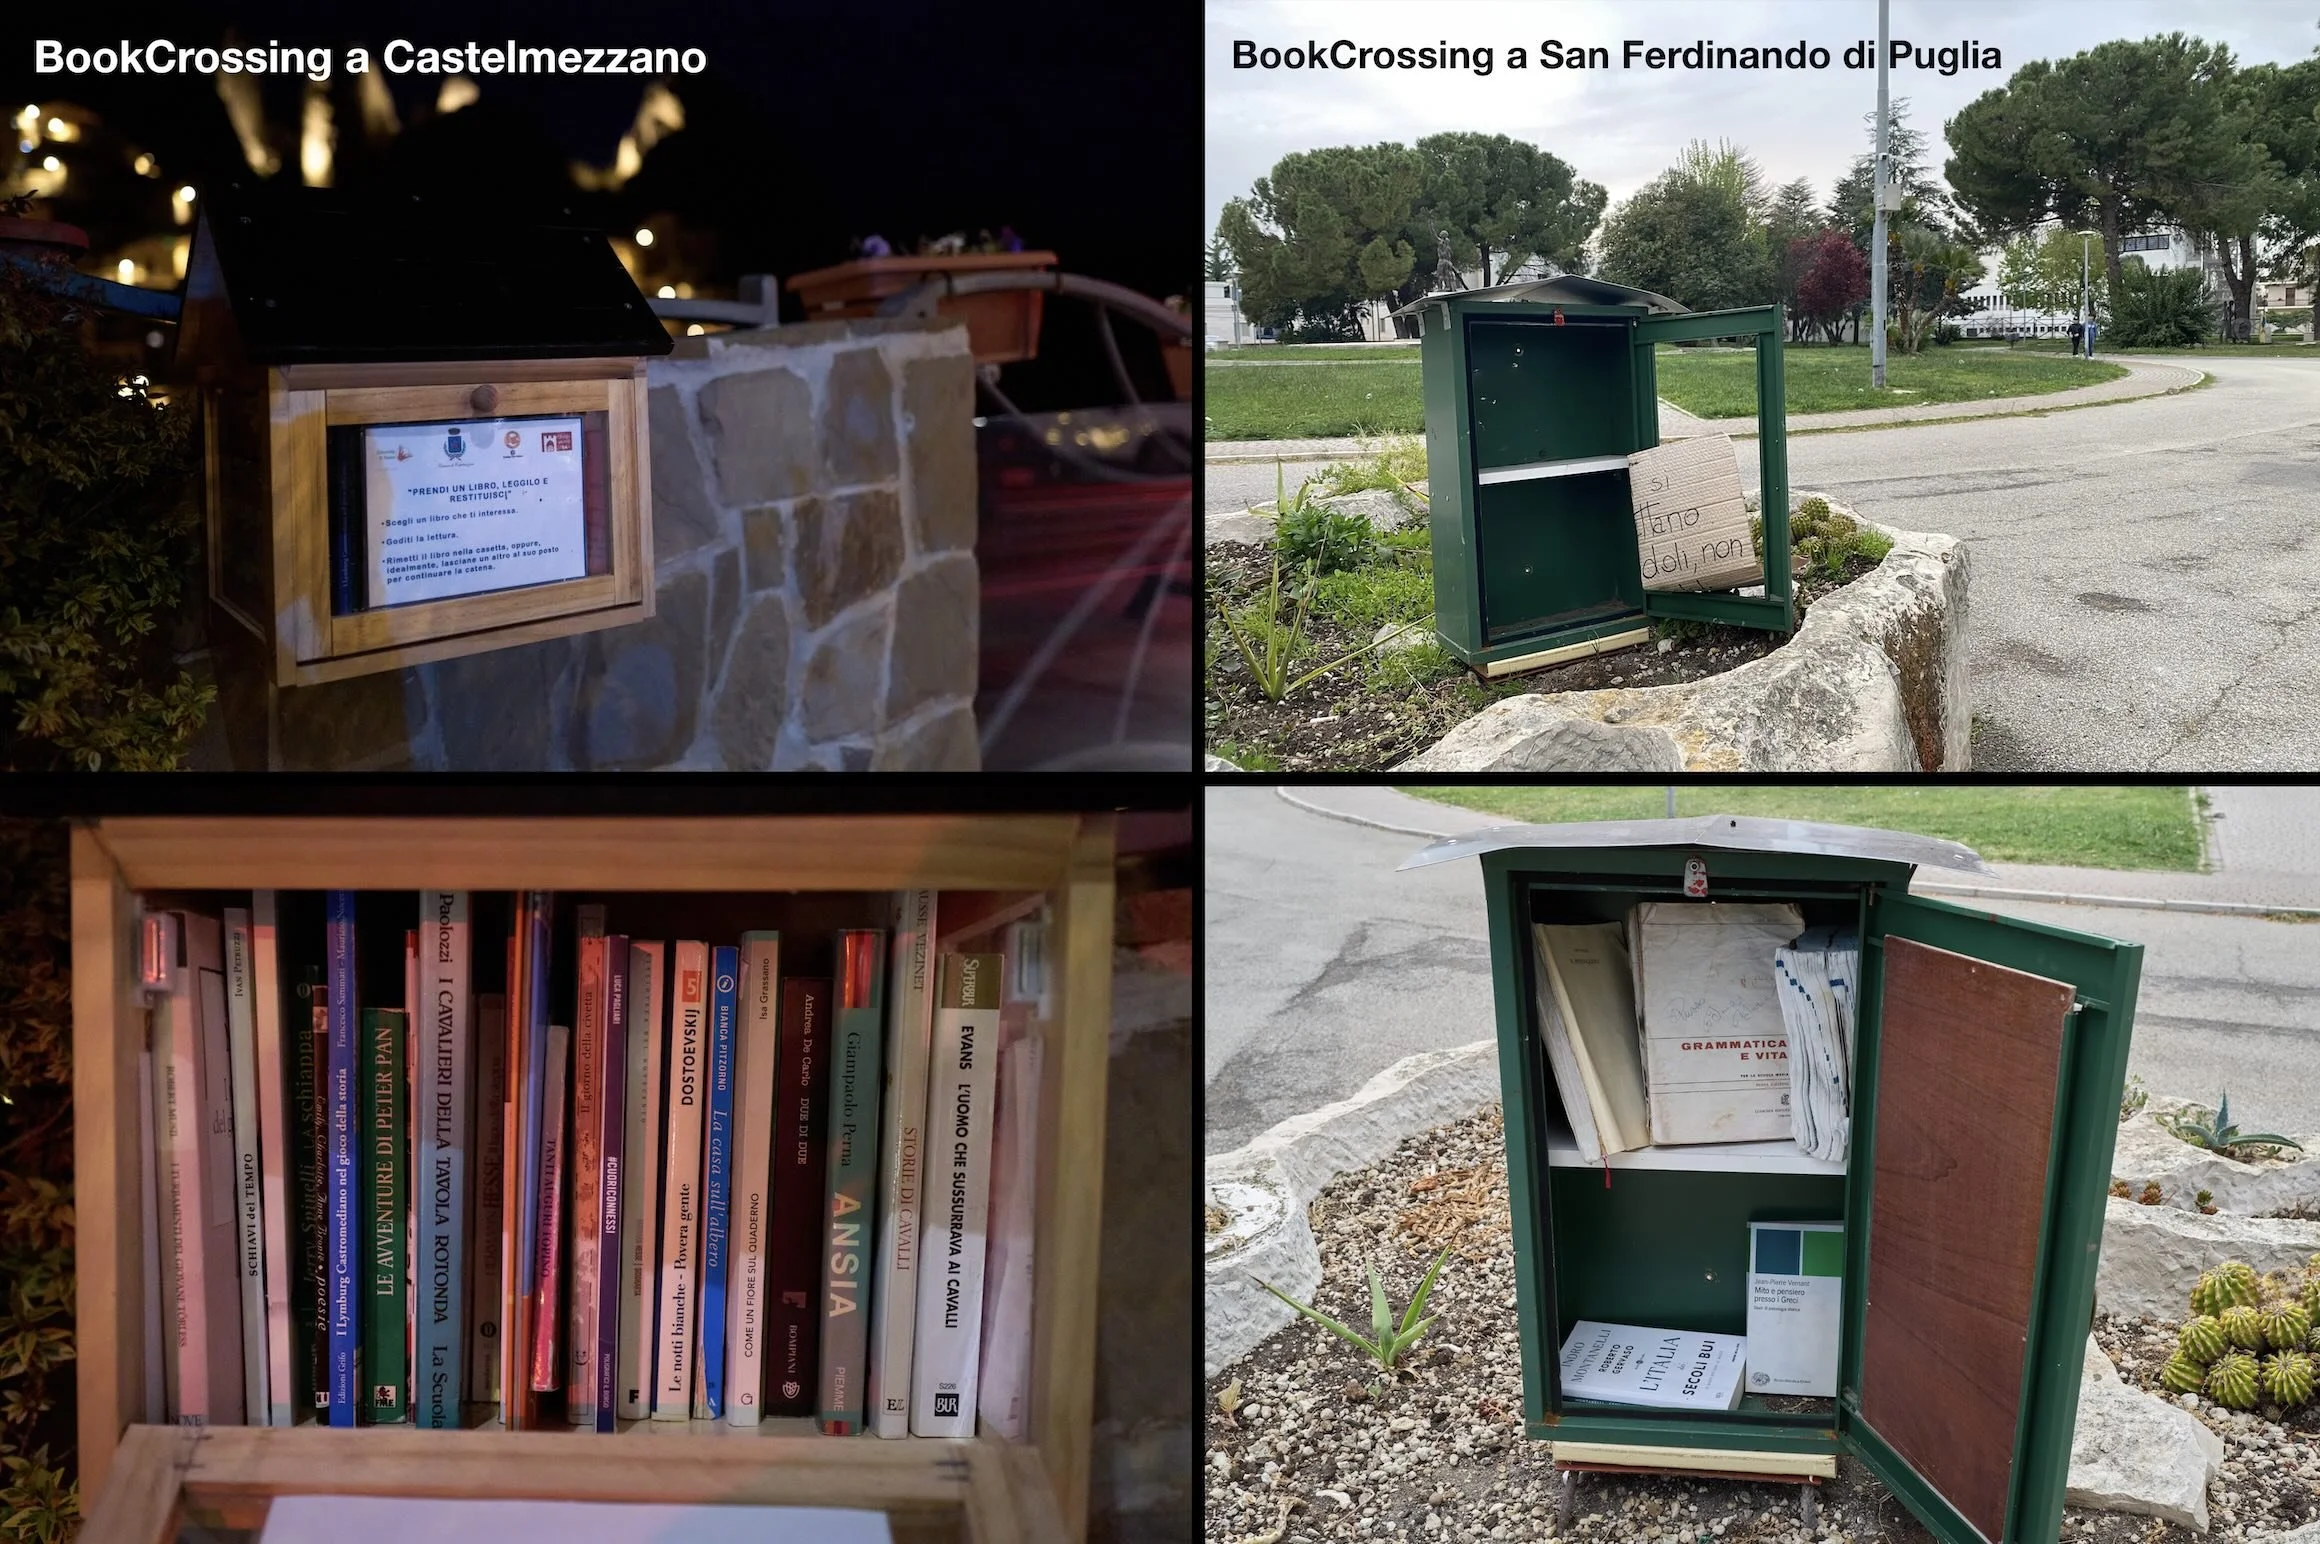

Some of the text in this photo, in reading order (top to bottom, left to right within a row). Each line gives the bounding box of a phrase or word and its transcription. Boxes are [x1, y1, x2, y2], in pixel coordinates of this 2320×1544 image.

[408, 478, 549, 496] "PRENDI UN LIBRO, LEGGILO E
[1651, 469, 1670, 492] si
[386, 536, 414, 546] Goditi
[427, 531, 459, 542] lettura.
[430, 512, 450, 523] libro
[452, 511, 467, 520] che
[470, 510, 476, 518] ti
[478, 507, 519, 518] interessa.
[386, 540, 542, 564] Rimetti il libro nella casetta, oppure,
[386, 562, 439, 574] idealmente,
[442, 557, 476, 567] lasciane
[492, 552, 510, 561] altro
[513, 550, 521, 558] al
[538, 546, 560, 556] posto
[387, 575, 402, 584] per
[405, 569, 452, 582] continuare
[465, 565, 496, 574] catena.
[1642, 538, 1744, 579] doli, non
[440, 894, 454, 964] Paolozzi
[686, 978, 698, 996] 5
[760, 958, 770, 1020] Isa Grassano
[914, 934, 928, 994] VEZINET
[582, 991, 594, 1028] civetta
[613, 975, 622, 1026] LUCA PAGLIARI
[337, 1006, 346, 1048] Francesco
[438, 989, 454, 1086] CAVALIERI
[582, 1032, 592, 1060] della
[718, 1006, 730, 1092] BIANCA PITZORNO
[802, 994, 815, 1088] Andrea De Carlo
[1681, 1040, 1788, 1051] GRAMMATICA
[296, 1030, 316, 1122] schiappa
[336, 1068, 347, 1096] storia
[682, 1008, 700, 1106] DOSTOEVSKIJ
[1740, 1052, 1788, 1061] E VITA
[166, 1066, 176, 1106] ROBERT
[581, 1063, 592, 1102] giorno
[841, 1032, 862, 1167] Giampaolo Perna
[336, 1099, 347, 1132] della
[436, 1094, 452, 1150] DELLA
[582, 1105, 591, 1114] Il
[798, 1098, 810, 1166] DUE DI DUE
[337, 1134, 350, 1166] gioco
[375, 1028, 394, 1298] LE AVVENTURE DI PETER PAN
[336, 1168, 348, 1186] nel
[436, 1157, 450, 1226] TAVOLA
[482, 1155, 500, 1208] HESSE
[606, 1156, 618, 1234] #CUORICONNESSI
[708, 1110, 728, 1268] La casa sull'albero
[897, 1127, 917, 1272] STORIE DI CAVALLI
[945, 1025, 975, 1330] EVANS L'UOMO CHE SUSSURRAVA AI CAVALLI
[244, 1153, 258, 1278] SCHIAVI del TEMPO
[336, 1188, 348, 1274] Castromediano
[541, 1139, 556, 1279] TANTI AUGURI TOPINO
[174, 1238, 184, 1256] DEL
[830, 1192, 861, 1318] ANSIA
[434, 1236, 450, 1324] ROTONDA
[668, 1184, 693, 1392] Le notti bianche Povera gente
[744, 1193, 760, 1358] COME UN FIORE SUL QUADERNO
[1754, 1296, 1776, 1304] presso
[1782, 1296, 1799, 1304] Greci
[1776, 1288, 1806, 1298] pensiero
[315, 1276, 330, 1332] poesie
[337, 1276, 350, 1331] Lymburg
[788, 1324, 798, 1374] BOMPIANI
[1562, 1342, 1586, 1368] INDRO
[1571, 1329, 1612, 1384] MONTANELLI
[1598, 1344, 1621, 1373] ROBERTO
[1612, 1345, 1634, 1375] GERVASO
[1640, 1336, 1682, 1392] L'ITALIA
[1682, 1361, 1707, 1396] SECOLI
[1703, 1340, 1716, 1360] BUI
[338, 1352, 346, 1404] Edizioni Grifo
[432, 1347, 448, 1429] La Scuola
[629, 1389, 640, 1404] F
[834, 1366, 846, 1412] PIEMME
[936, 1397, 958, 1414] BUR
